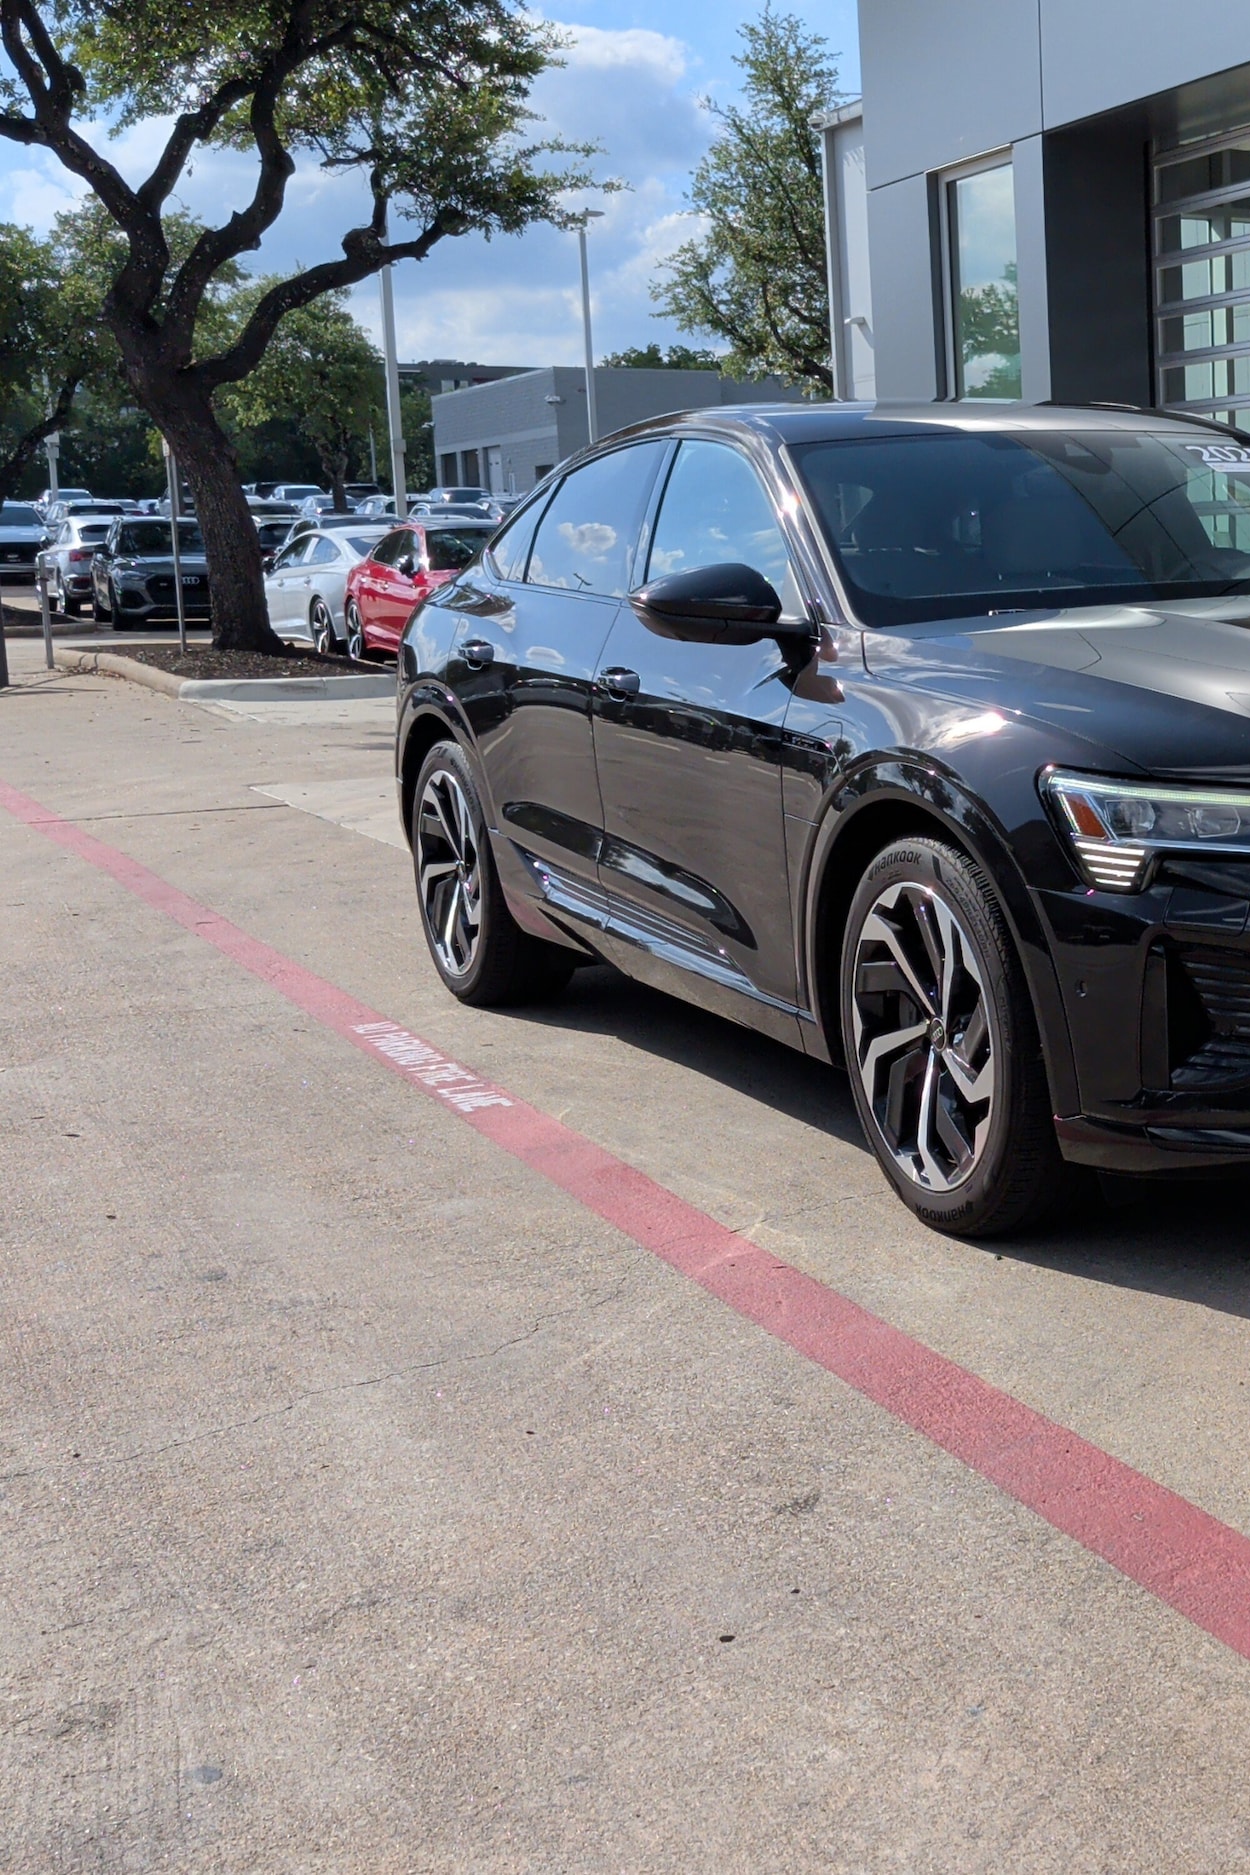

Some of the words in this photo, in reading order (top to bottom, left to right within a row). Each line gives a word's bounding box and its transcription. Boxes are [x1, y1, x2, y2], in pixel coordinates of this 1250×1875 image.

[351, 1020, 399, 1034] NO
[364, 1031, 444, 1065] PARKING
[407, 1063, 477, 1086] FIRE
[437, 1084, 514, 1112] LANE
